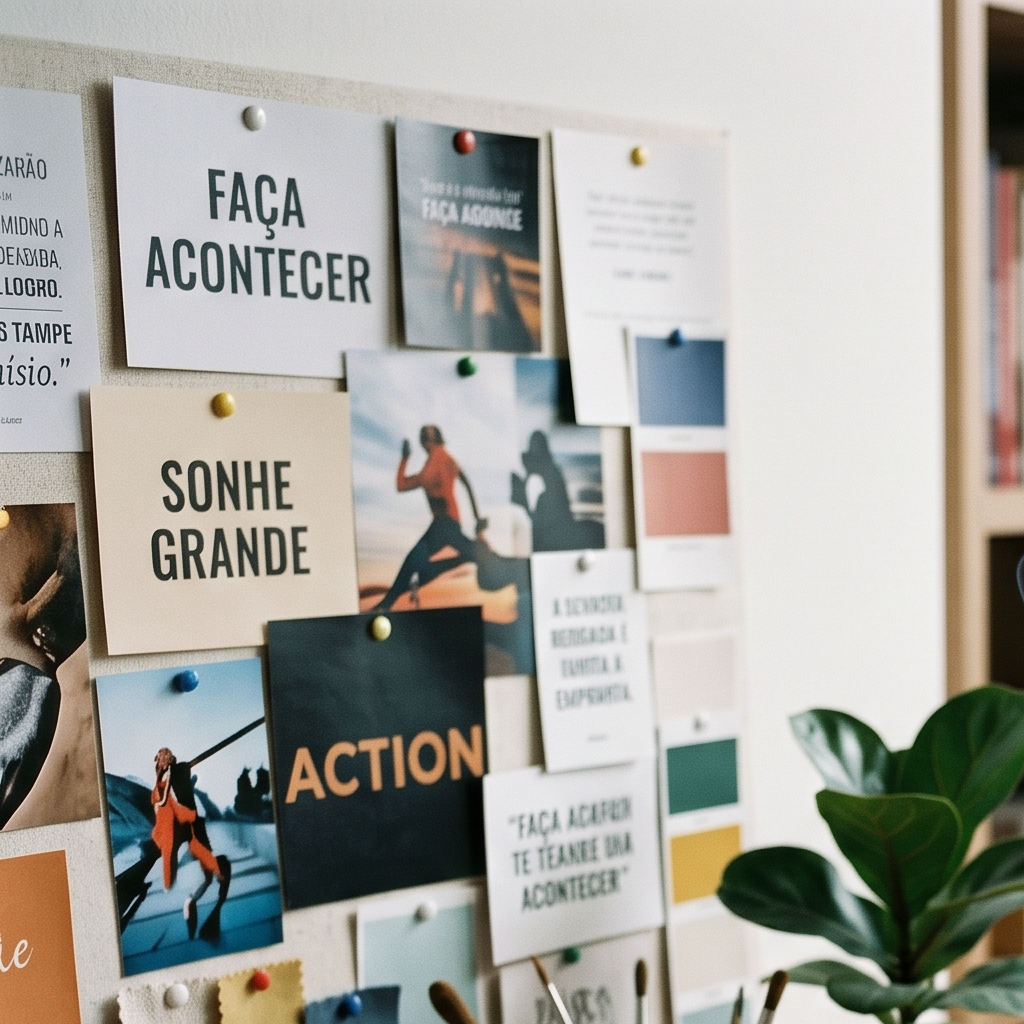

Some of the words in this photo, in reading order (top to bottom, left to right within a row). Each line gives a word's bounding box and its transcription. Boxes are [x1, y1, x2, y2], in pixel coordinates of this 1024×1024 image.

[54, 219, 64, 239] A
[207, 168, 306, 241] FAÇA
[145, 236, 372, 304] ACONTECER
[12, 322, 73, 345] TAMPE
[160, 459, 294, 513] SONHE
[150, 526, 311, 582] GRANDE
[285, 724, 485, 804] ACTION
[512, 849, 530, 875] TE
